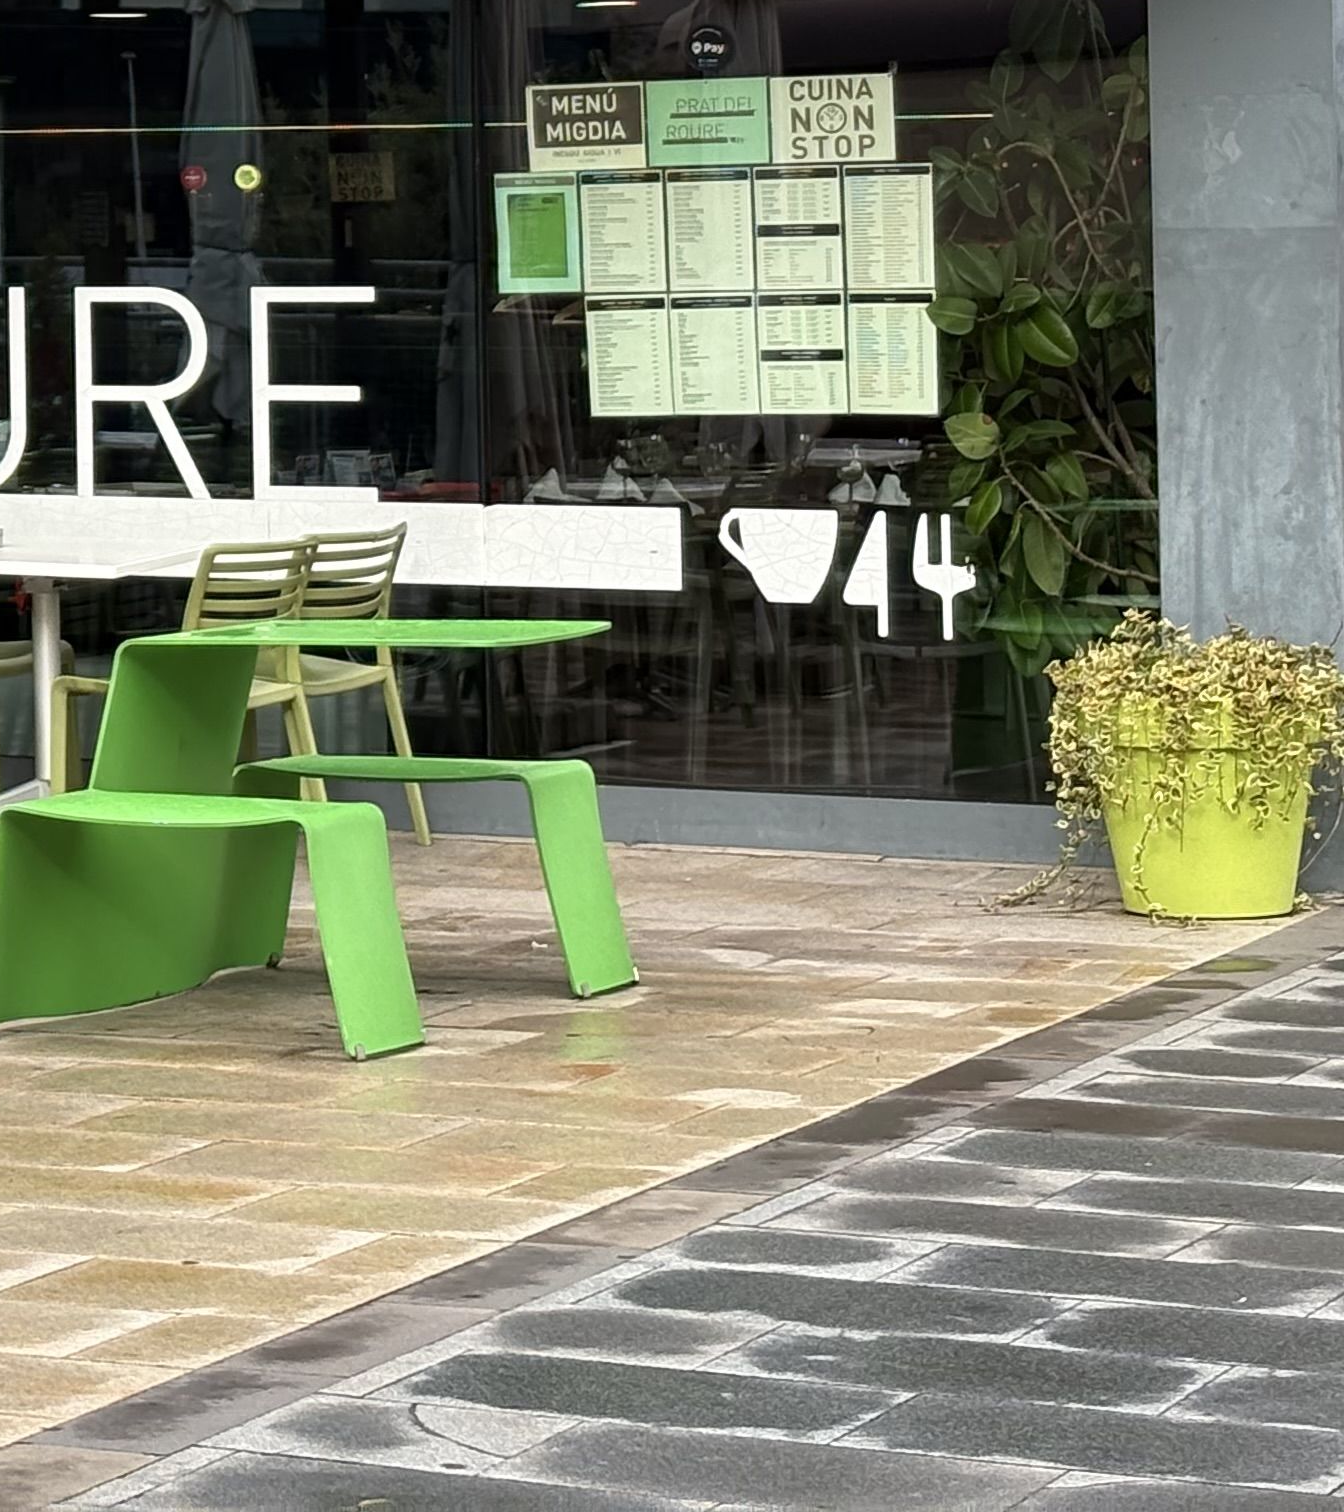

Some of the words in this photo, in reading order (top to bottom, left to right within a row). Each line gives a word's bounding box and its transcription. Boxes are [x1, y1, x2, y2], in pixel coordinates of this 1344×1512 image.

[703, 42, 725, 55] Pay
[789, 77, 874, 102] CUINA
[551, 88, 617, 116] MENÚ
[675, 96, 720, 113] PRAT
[545, 120, 627, 143] MIGDIA
[665, 123, 725, 139] ROURE
[791, 134, 876, 160] STOP
[338, 186, 384, 201] STOP
